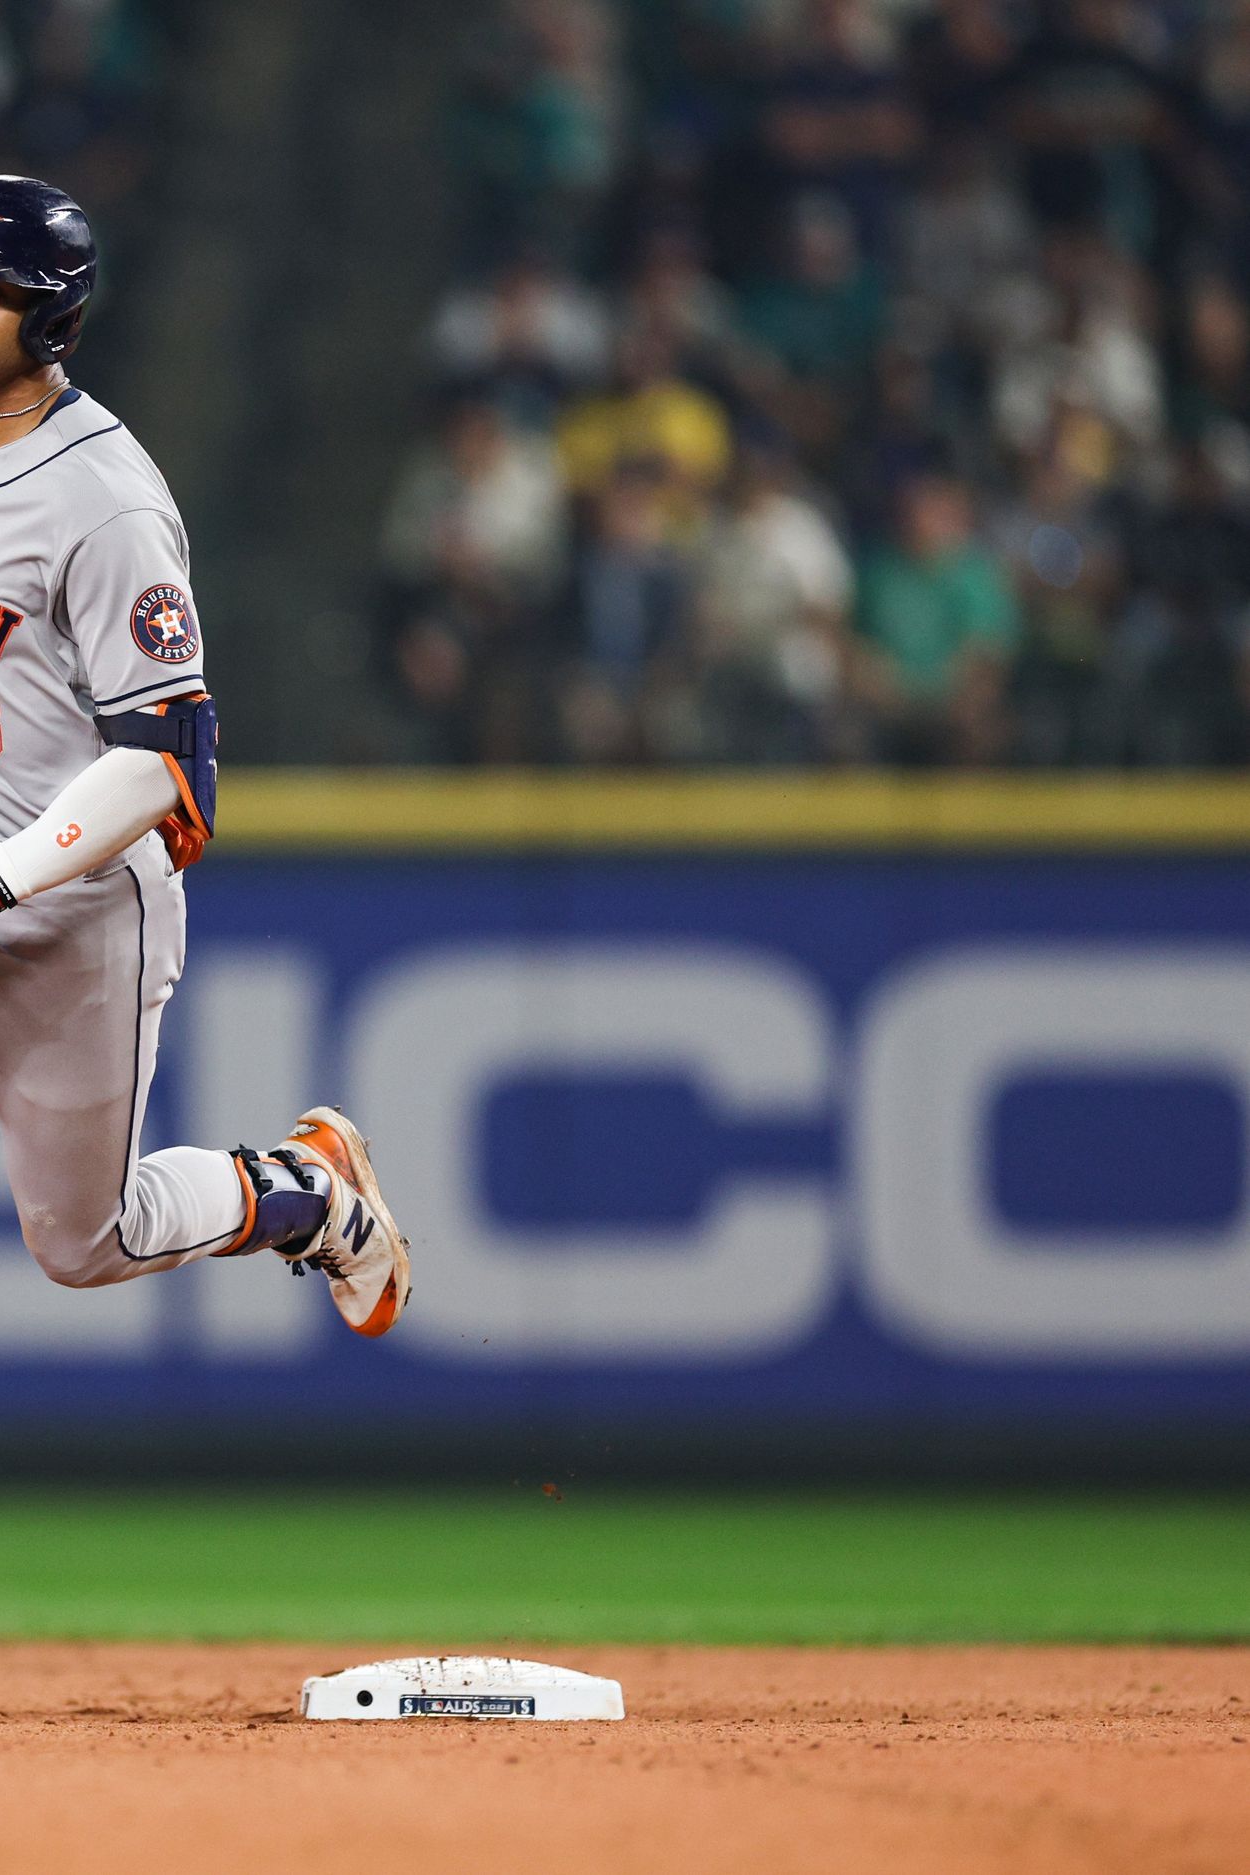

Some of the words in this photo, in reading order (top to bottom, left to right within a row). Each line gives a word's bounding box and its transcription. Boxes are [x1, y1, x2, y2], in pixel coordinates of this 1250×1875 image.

[136, 588, 185, 618] HOUSTON
[153, 636, 197, 659] ASTROS
[56, 822, 82, 848] 3
[442, 1700, 481, 1713] ALDS
